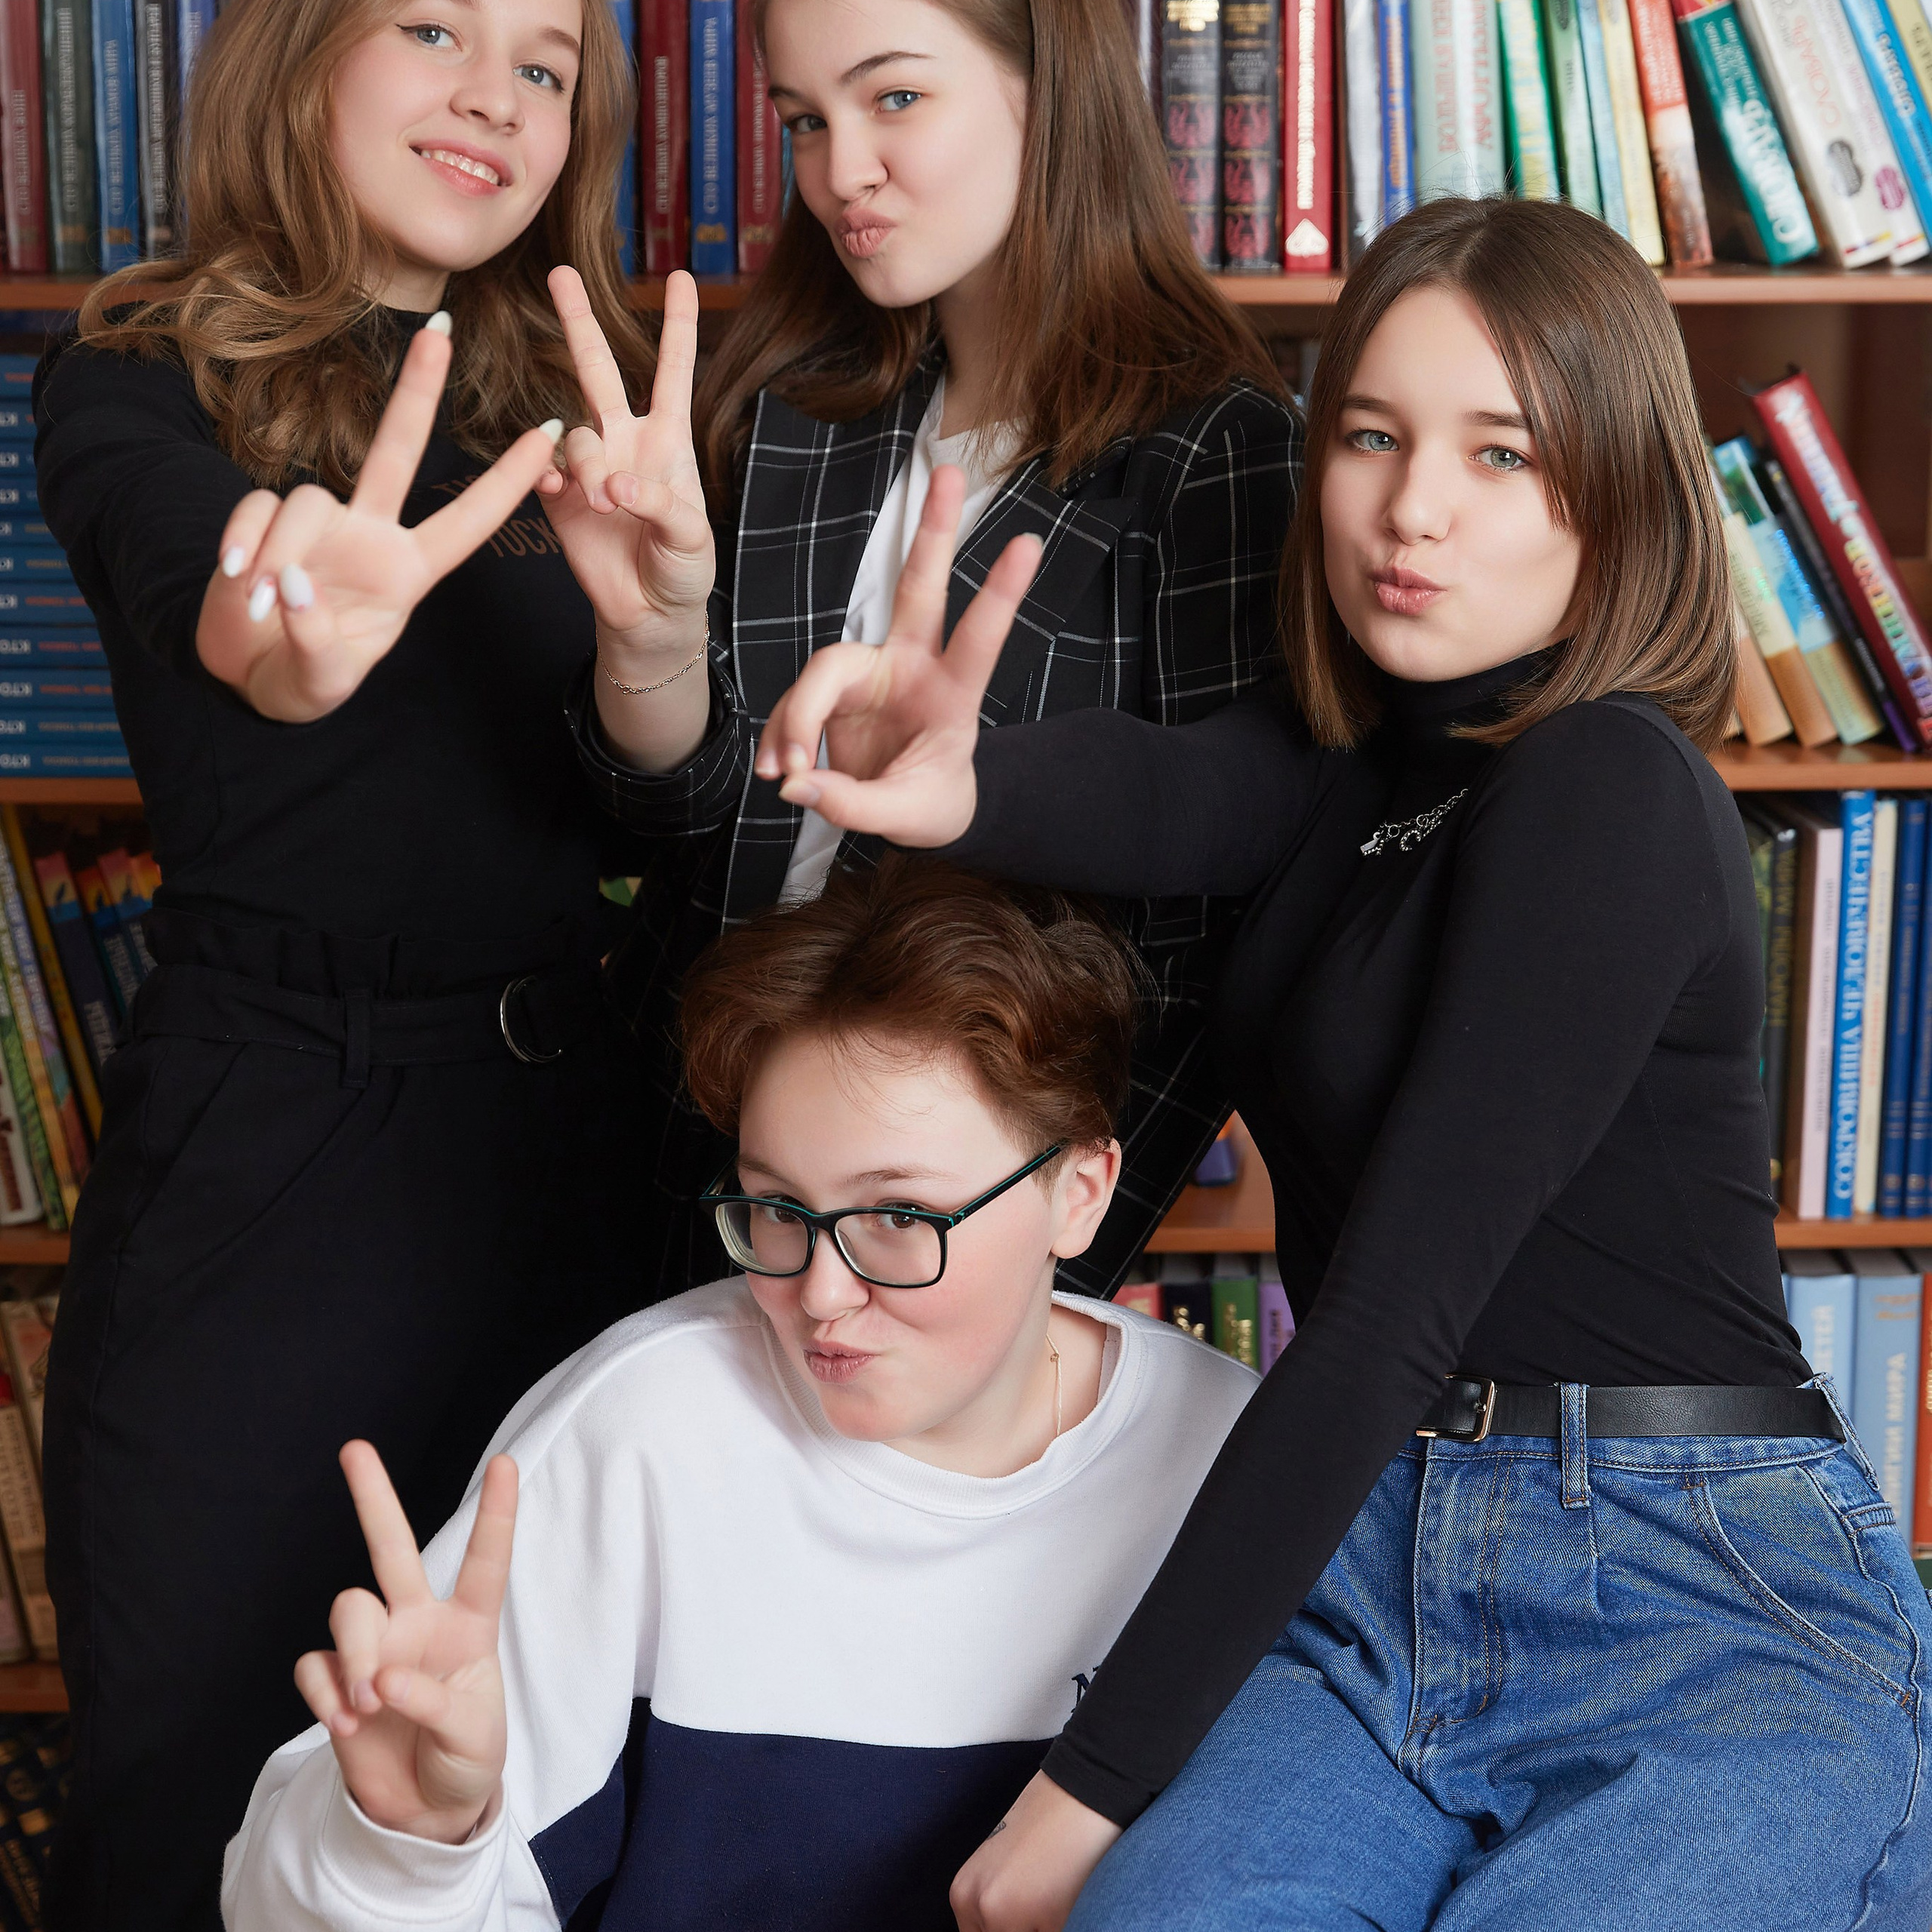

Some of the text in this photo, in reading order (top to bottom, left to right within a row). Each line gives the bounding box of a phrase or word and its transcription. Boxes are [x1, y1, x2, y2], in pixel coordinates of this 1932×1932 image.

[703, 115, 719, 181] ВЕЛИКИХ
[704, 183, 719, 214] СТО
[1737, 98, 1803, 246] СЛОВАРЬ
[1832, 811, 1873, 1200] СОКРОВИЩА ЧЕЛОВЕЧЕСТВА
